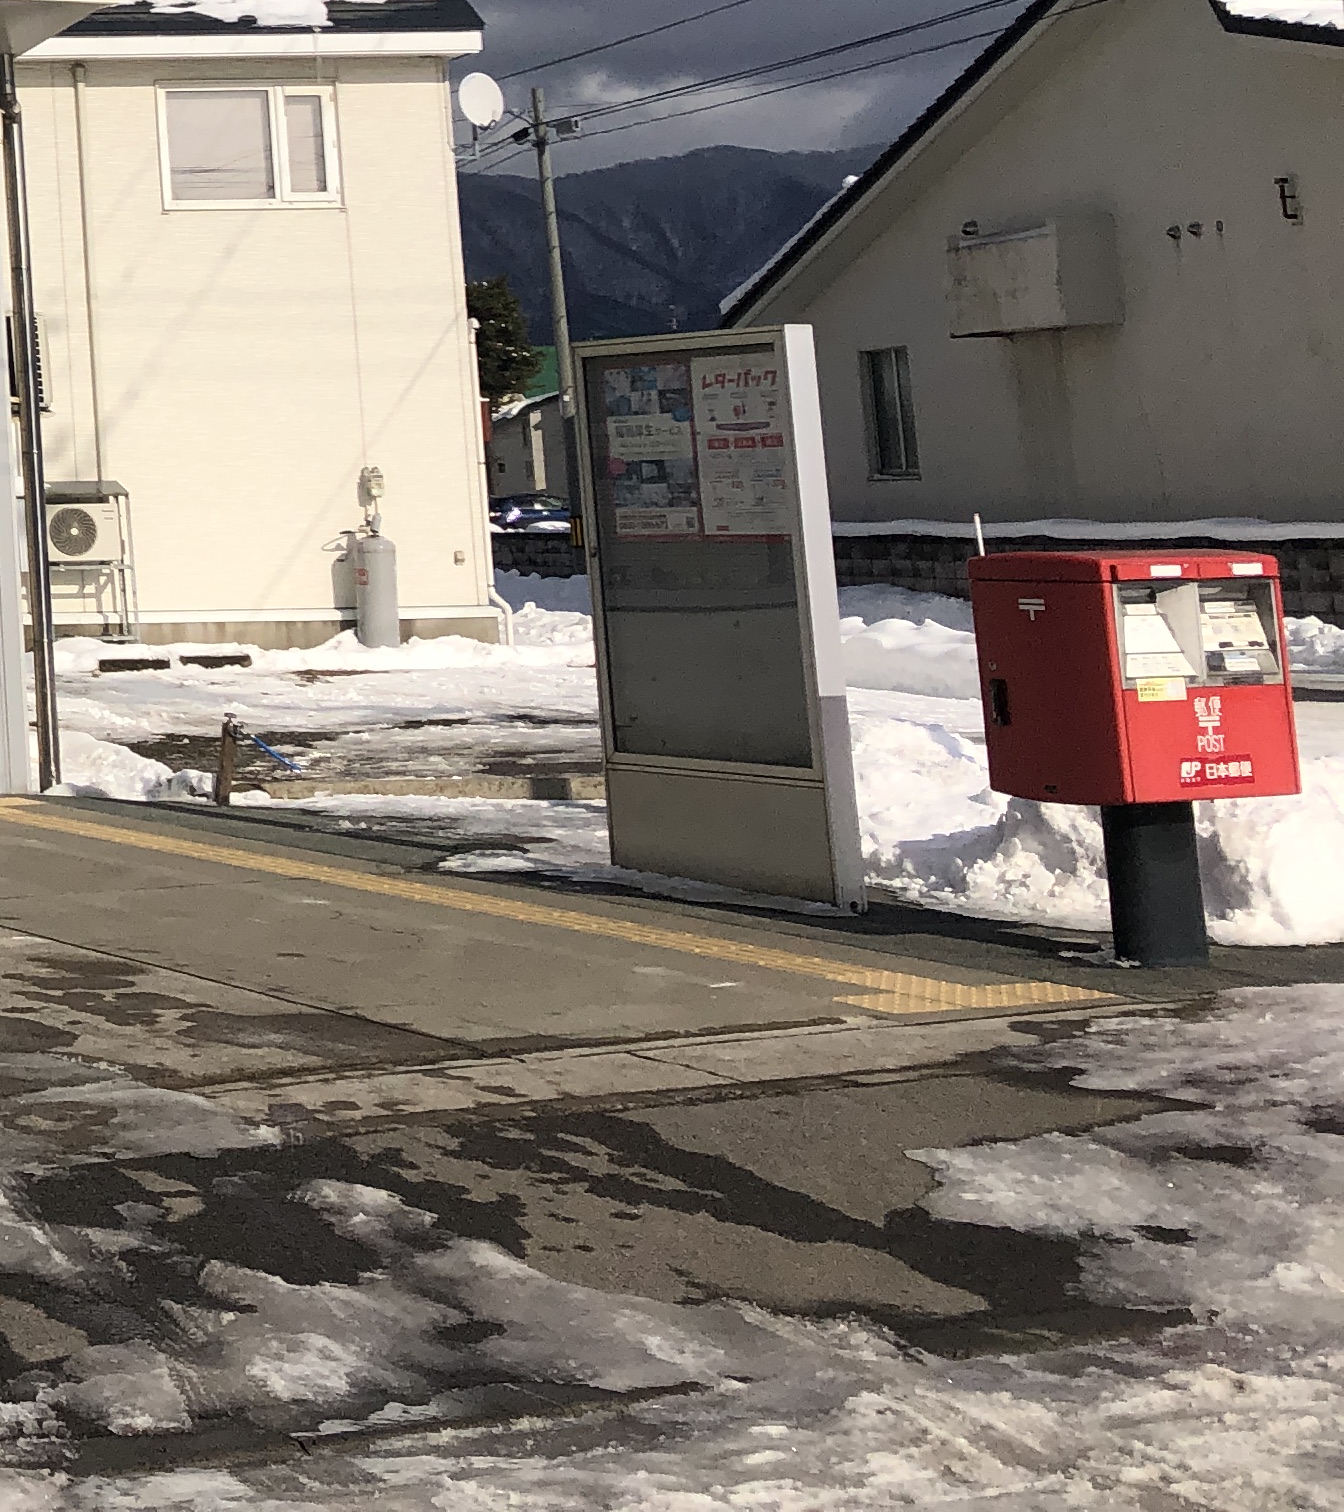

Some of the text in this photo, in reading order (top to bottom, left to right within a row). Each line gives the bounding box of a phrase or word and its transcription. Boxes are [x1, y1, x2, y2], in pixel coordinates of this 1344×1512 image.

[701, 368, 778, 391] レターパック
[1193, 696, 1223, 717] 郵便
[1197, 735, 1225, 753] POST
[1205, 761, 1253, 779] 日本郵便
